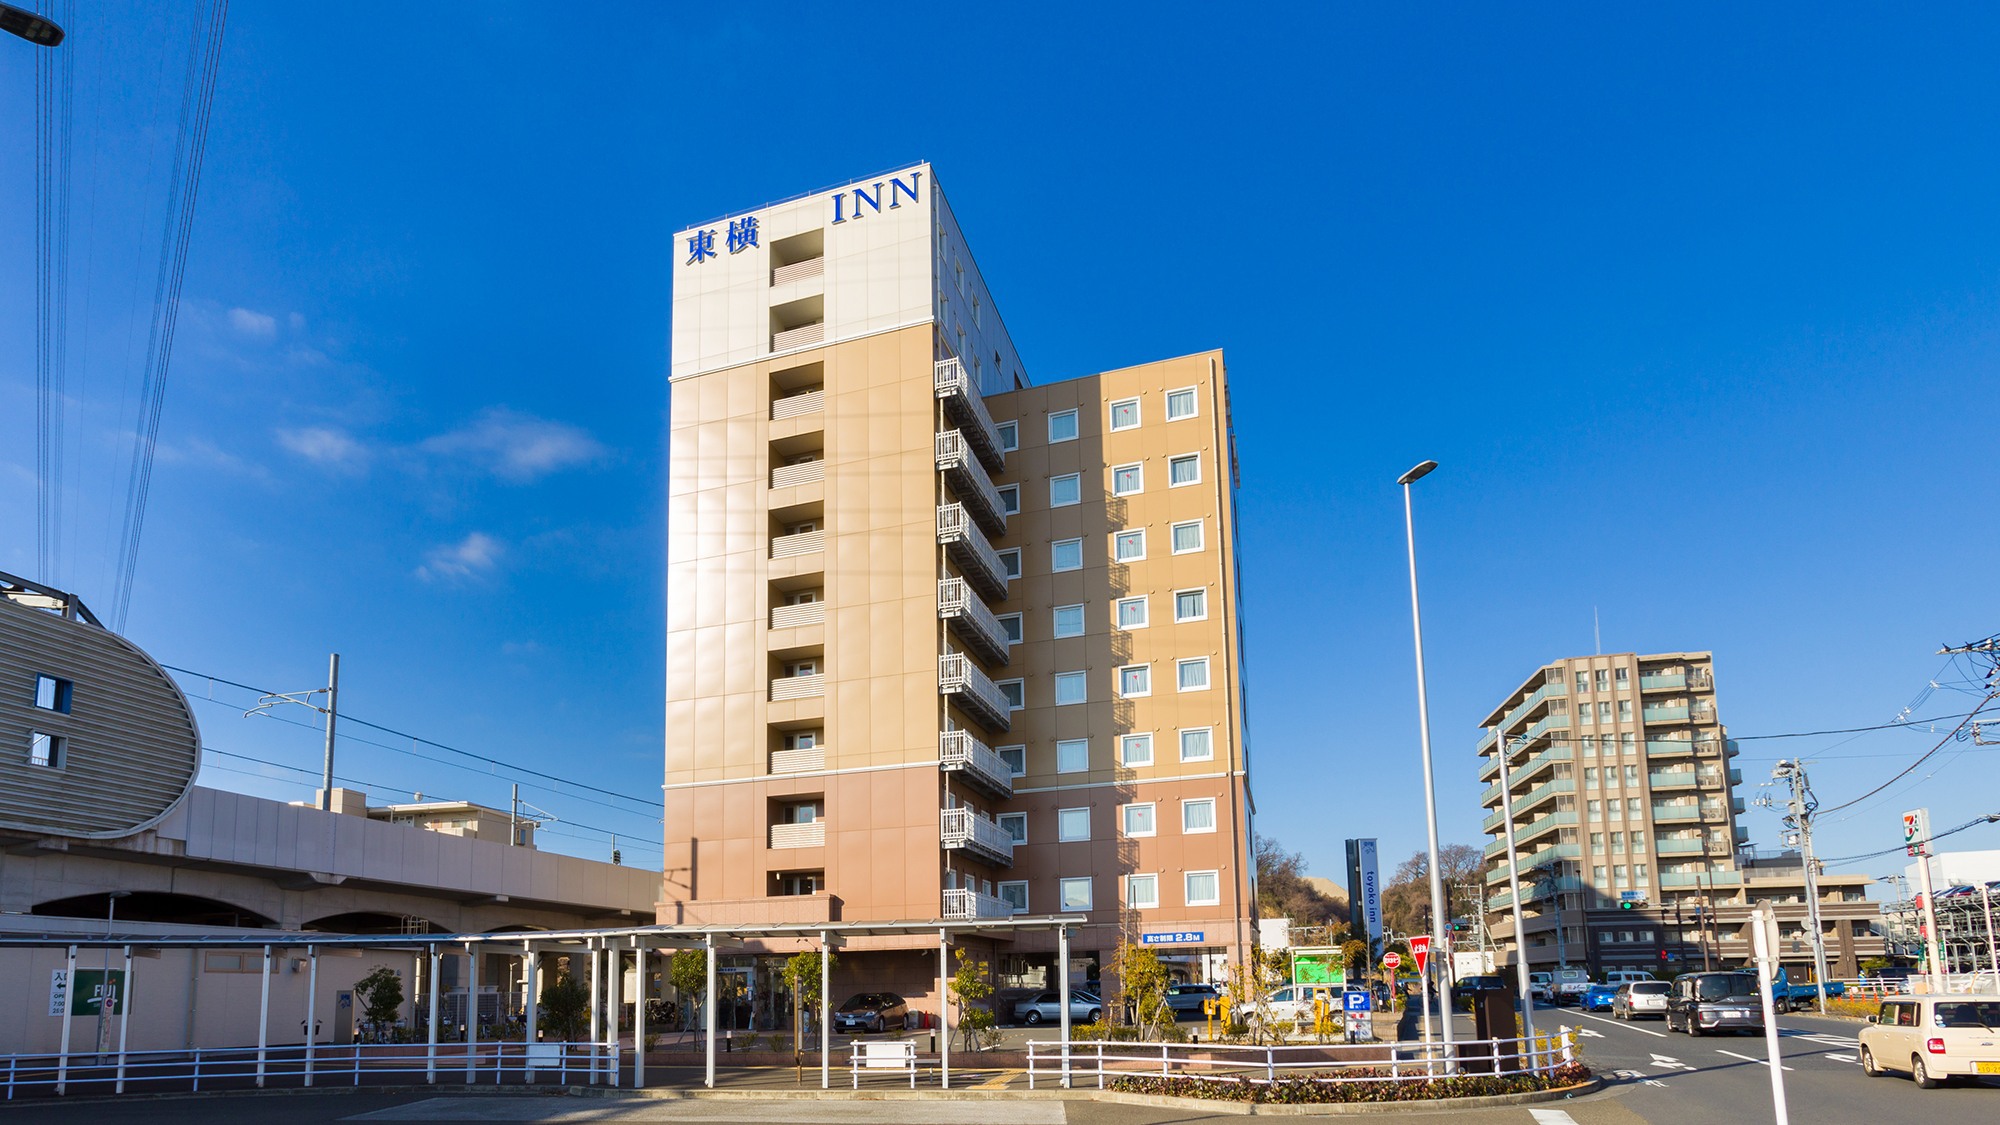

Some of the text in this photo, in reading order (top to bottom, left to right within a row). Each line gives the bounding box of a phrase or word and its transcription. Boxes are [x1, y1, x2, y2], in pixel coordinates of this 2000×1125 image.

[685, 171, 922, 266] 東横 INN
[1365, 871, 1377, 923] toyoko inn
[1348, 994, 1365, 1009] P
